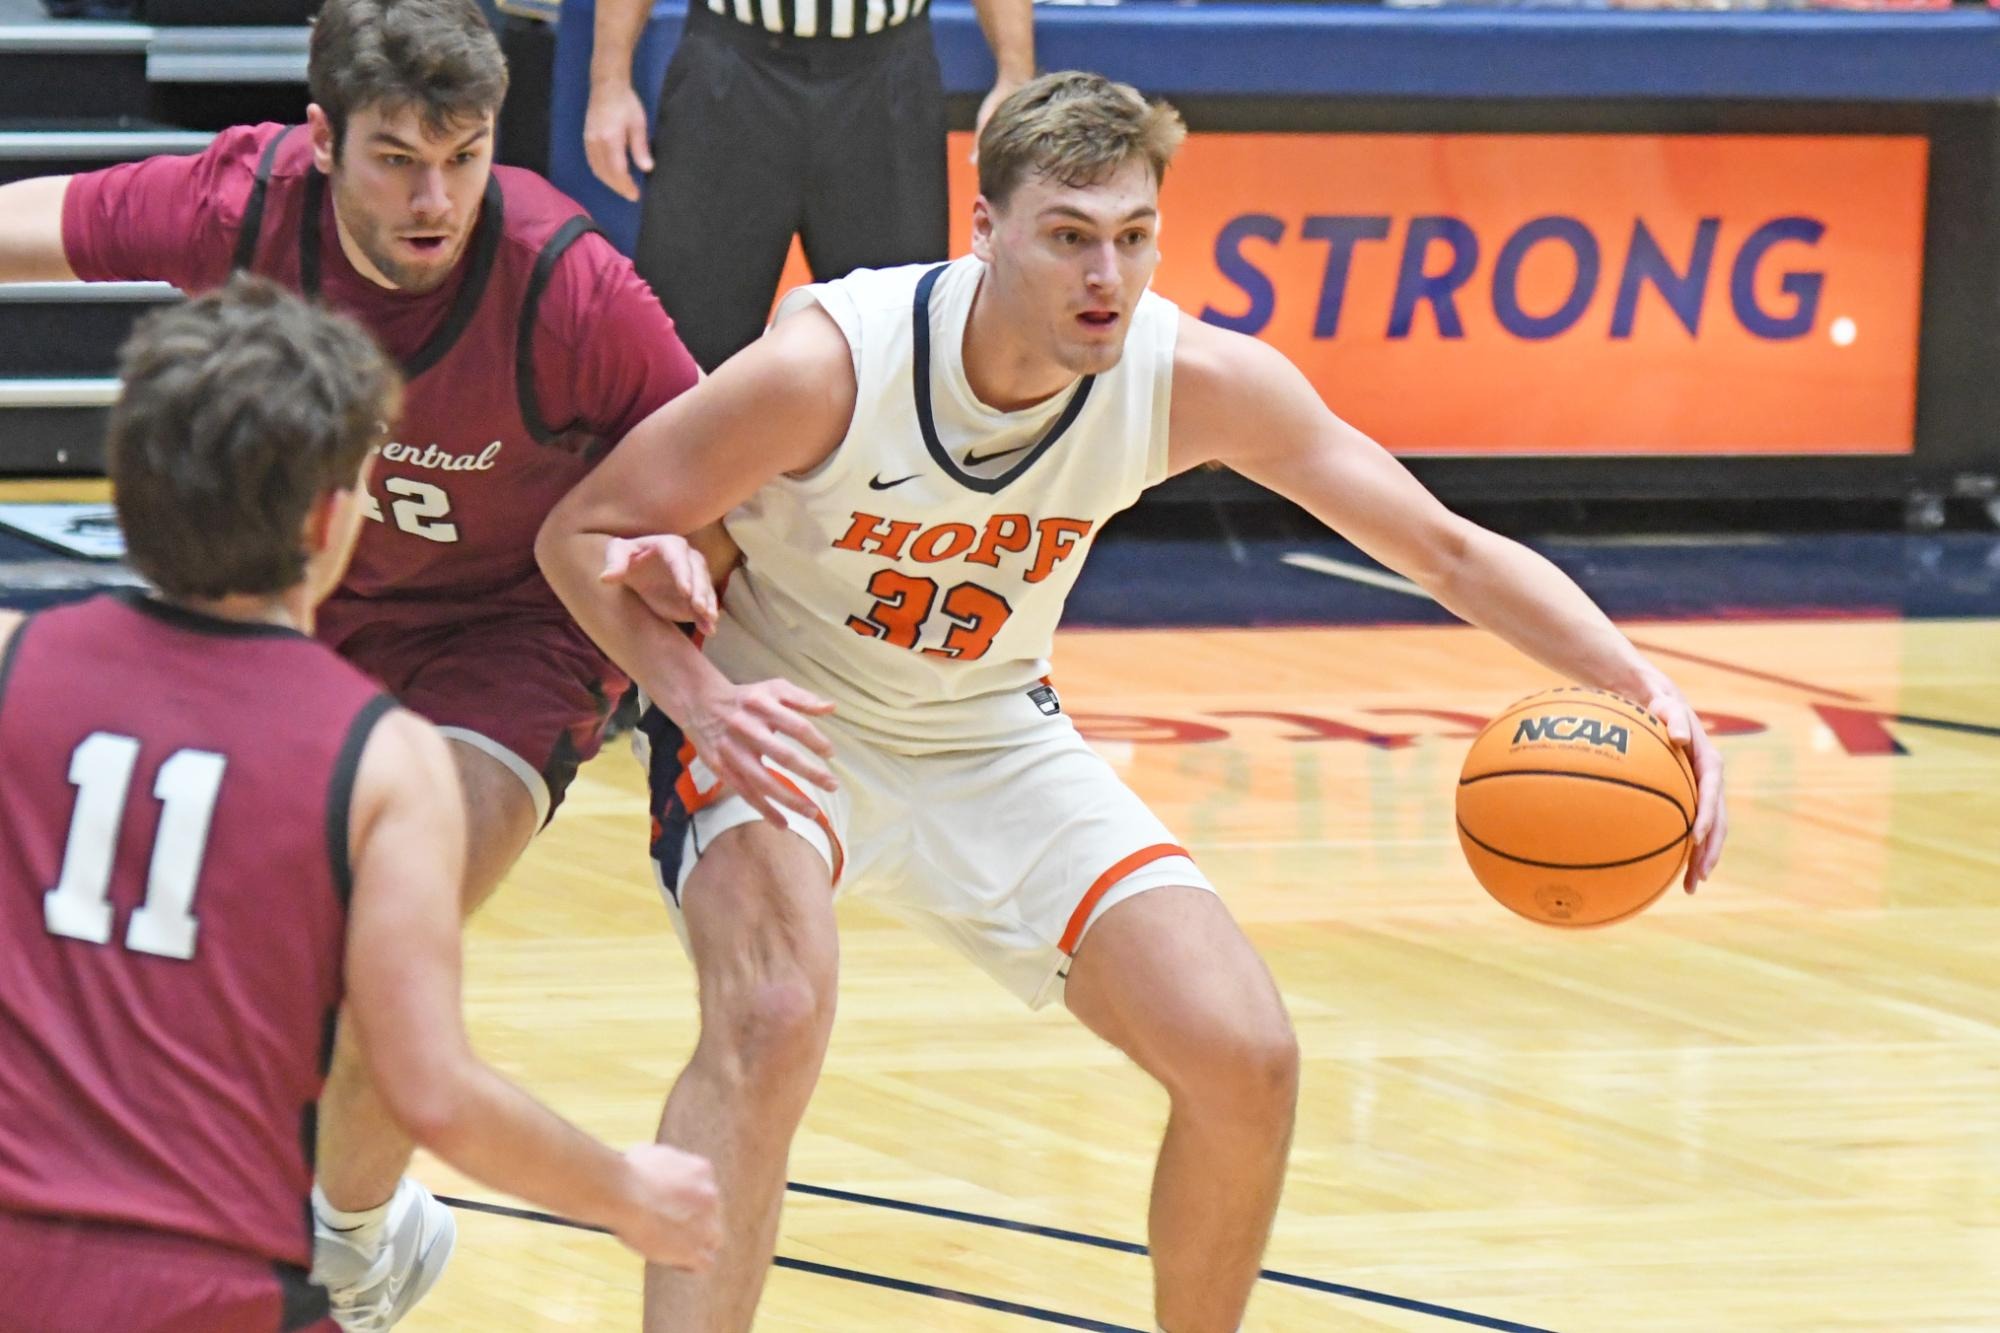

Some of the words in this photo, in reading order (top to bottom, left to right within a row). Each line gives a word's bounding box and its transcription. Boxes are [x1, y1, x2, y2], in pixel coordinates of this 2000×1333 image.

[1199, 213, 1858, 342] STRONG.
[845, 568, 1013, 661] 33
[1511, 716, 1629, 755] NCAA
[44, 730, 229, 961] 11
